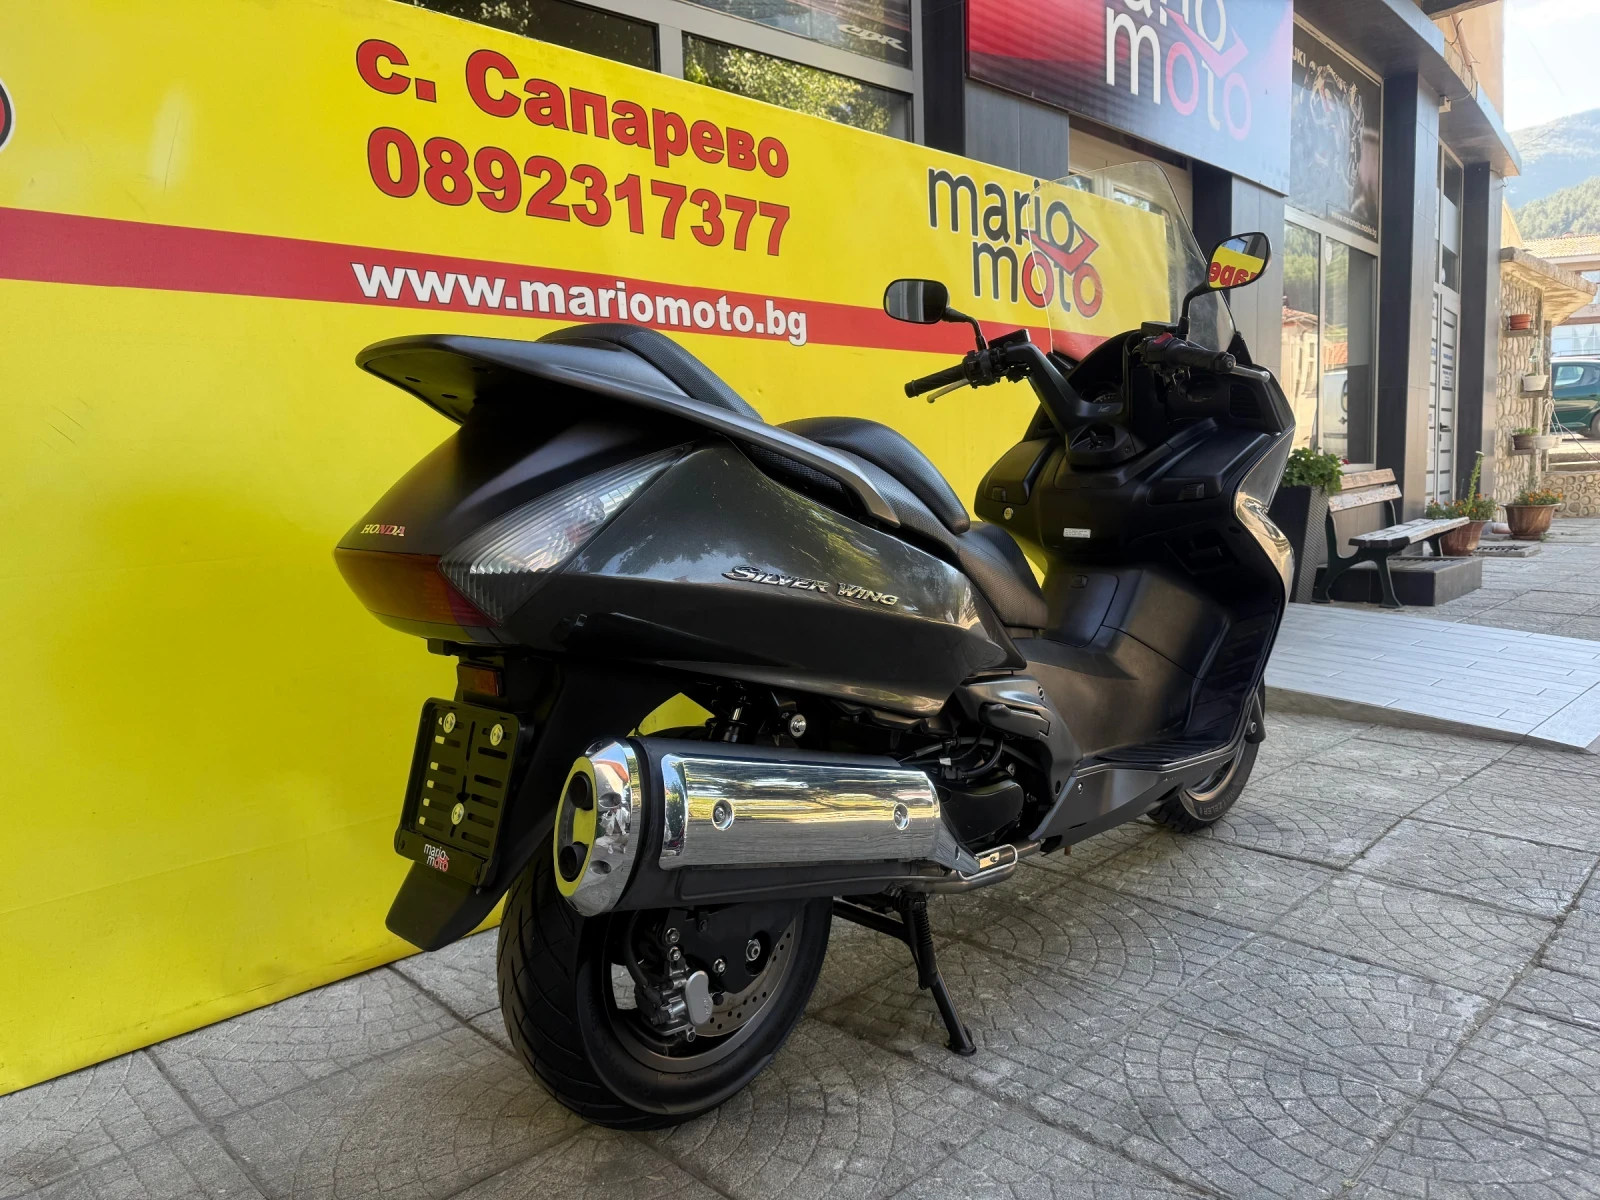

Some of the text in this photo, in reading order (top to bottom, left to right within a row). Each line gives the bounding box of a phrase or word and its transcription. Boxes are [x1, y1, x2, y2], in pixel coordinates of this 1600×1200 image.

[356, 39, 790, 178] с. Сапарево
[367, 126, 790, 256] 0892317377
[928, 168, 1075, 255] mario
[350, 262, 808, 346] www.mariomoto.bg
[972, 241, 1104, 318] moto
[360, 524, 406, 537] HONDA
[722, 565, 899, 606] SILVER WING
[423, 843, 446, 860] mario
[426, 855, 448, 872] moto
